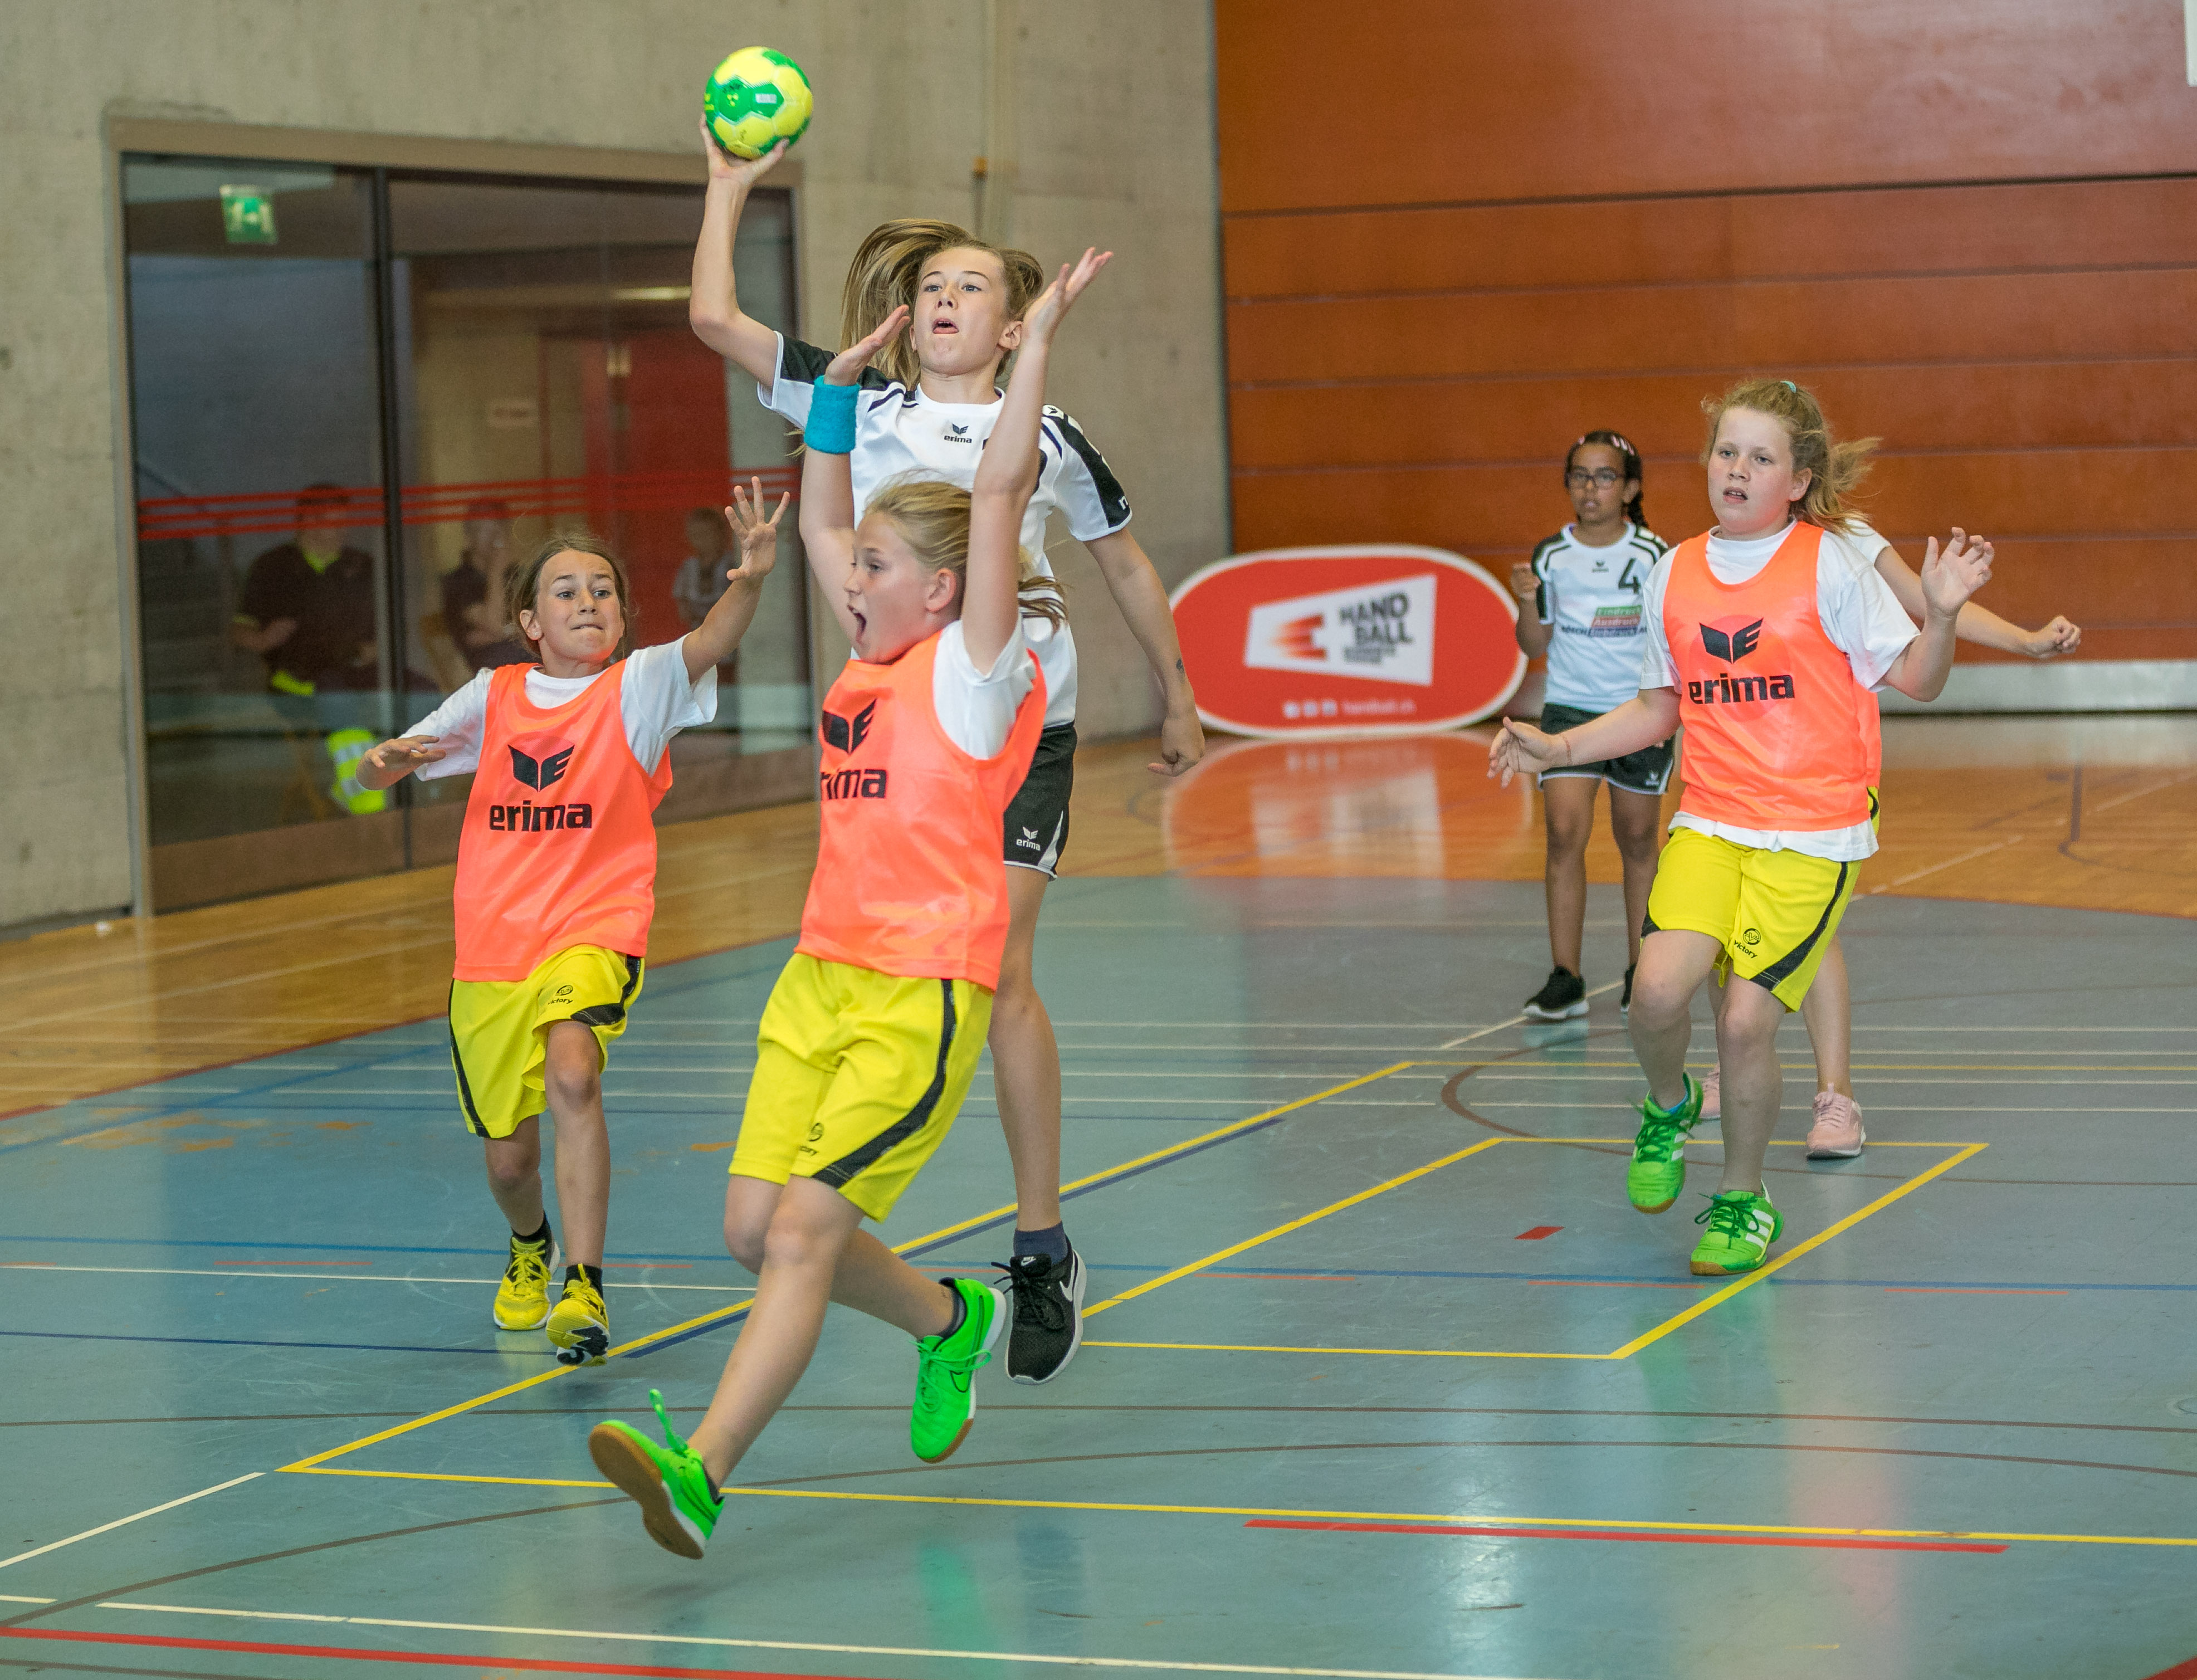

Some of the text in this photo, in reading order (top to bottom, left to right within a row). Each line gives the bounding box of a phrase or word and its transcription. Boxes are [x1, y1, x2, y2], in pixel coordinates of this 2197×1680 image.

[944, 435, 972, 443] erima
[1618, 558, 1641, 594] 4
[1688, 673, 1795, 704] erima
[489, 800, 592, 832] erima
[1016, 839, 1041, 851] erima
[1734, 940, 1757, 959] victory
